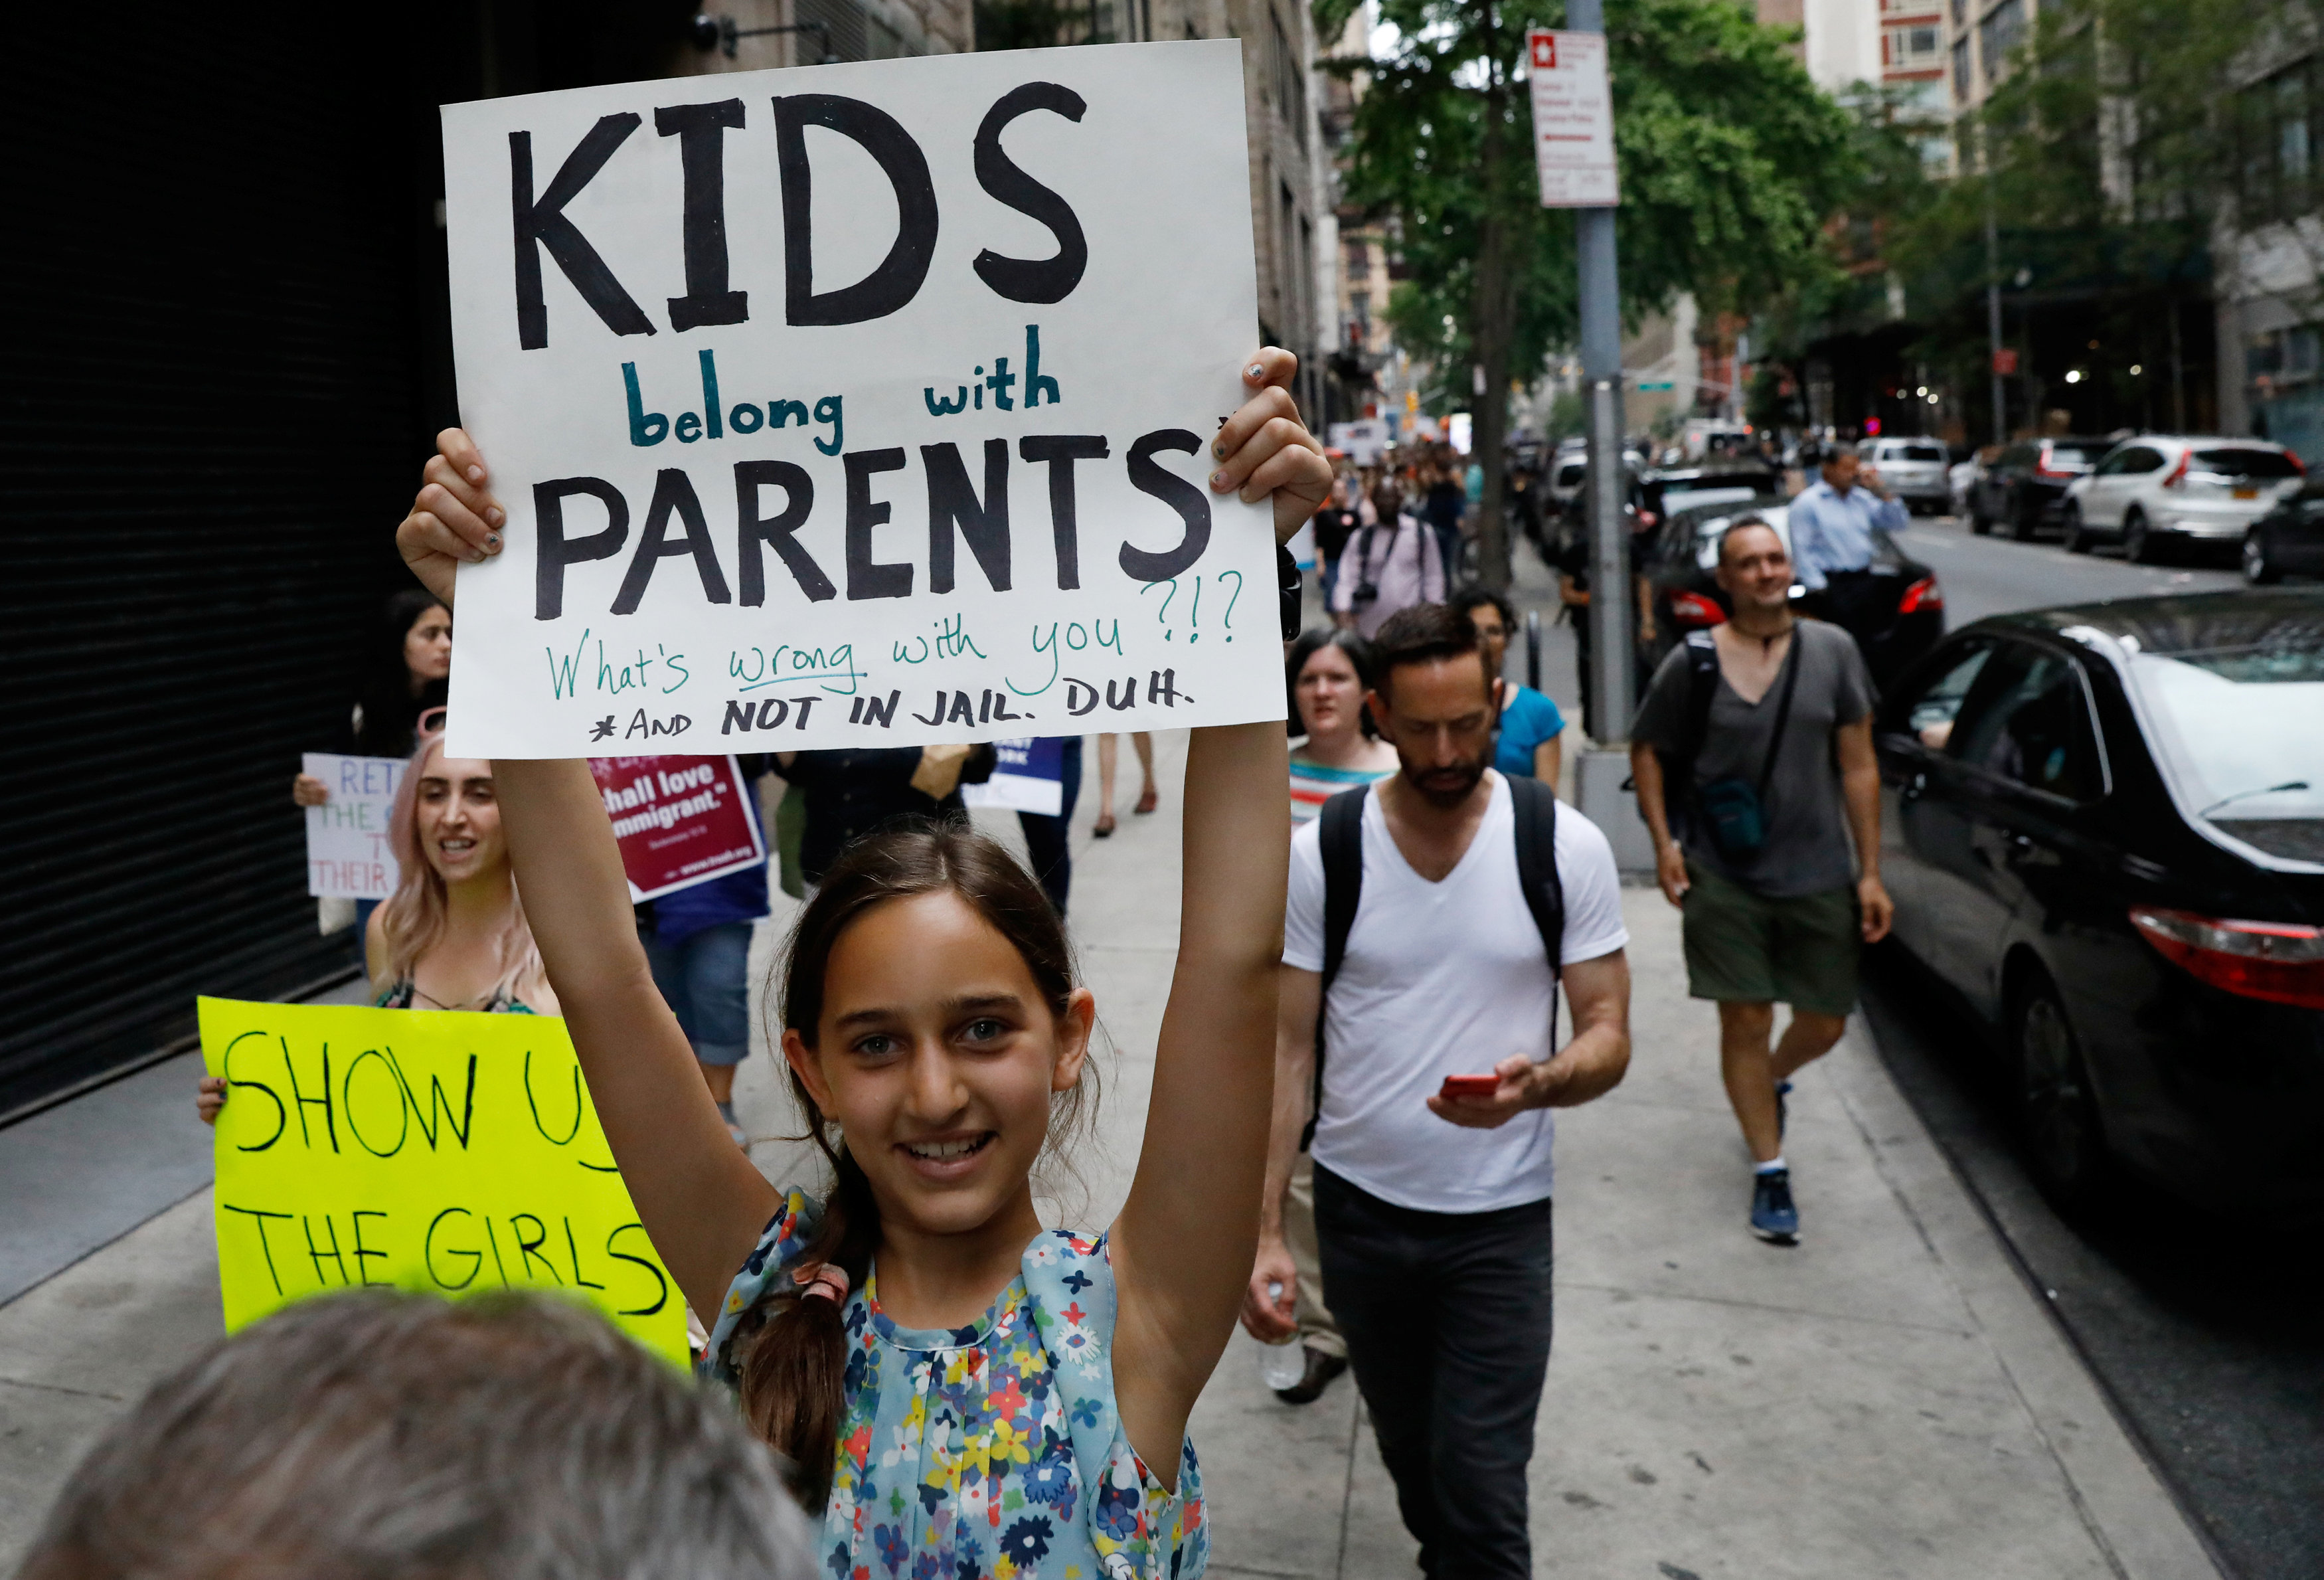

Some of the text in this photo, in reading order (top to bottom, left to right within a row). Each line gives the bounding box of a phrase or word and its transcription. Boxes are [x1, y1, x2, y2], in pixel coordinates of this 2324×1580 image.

[508, 81, 1089, 351] KIDS
[622, 324, 1061, 458] belong with
[546, 570, 1242, 701] What's wrong with you ?!?
[721, 695, 823, 735] NOT
[849, 689, 902, 729] IN
[912, 687, 1036, 727] JAIL.
[1062, 667, 1195, 717] DUH.
[339, 759, 409, 795] RET
[602, 773, 657, 814] hall
[657, 763, 715, 798] love
[319, 802, 375, 831] THE
[611, 782, 728, 839] mmigrant."
[311, 859, 389, 892] THEIR
[366, 833, 387, 860] T
[224, 1031, 478, 1158] SHOW
[224, 1203, 668, 1317] THE GIRLS
